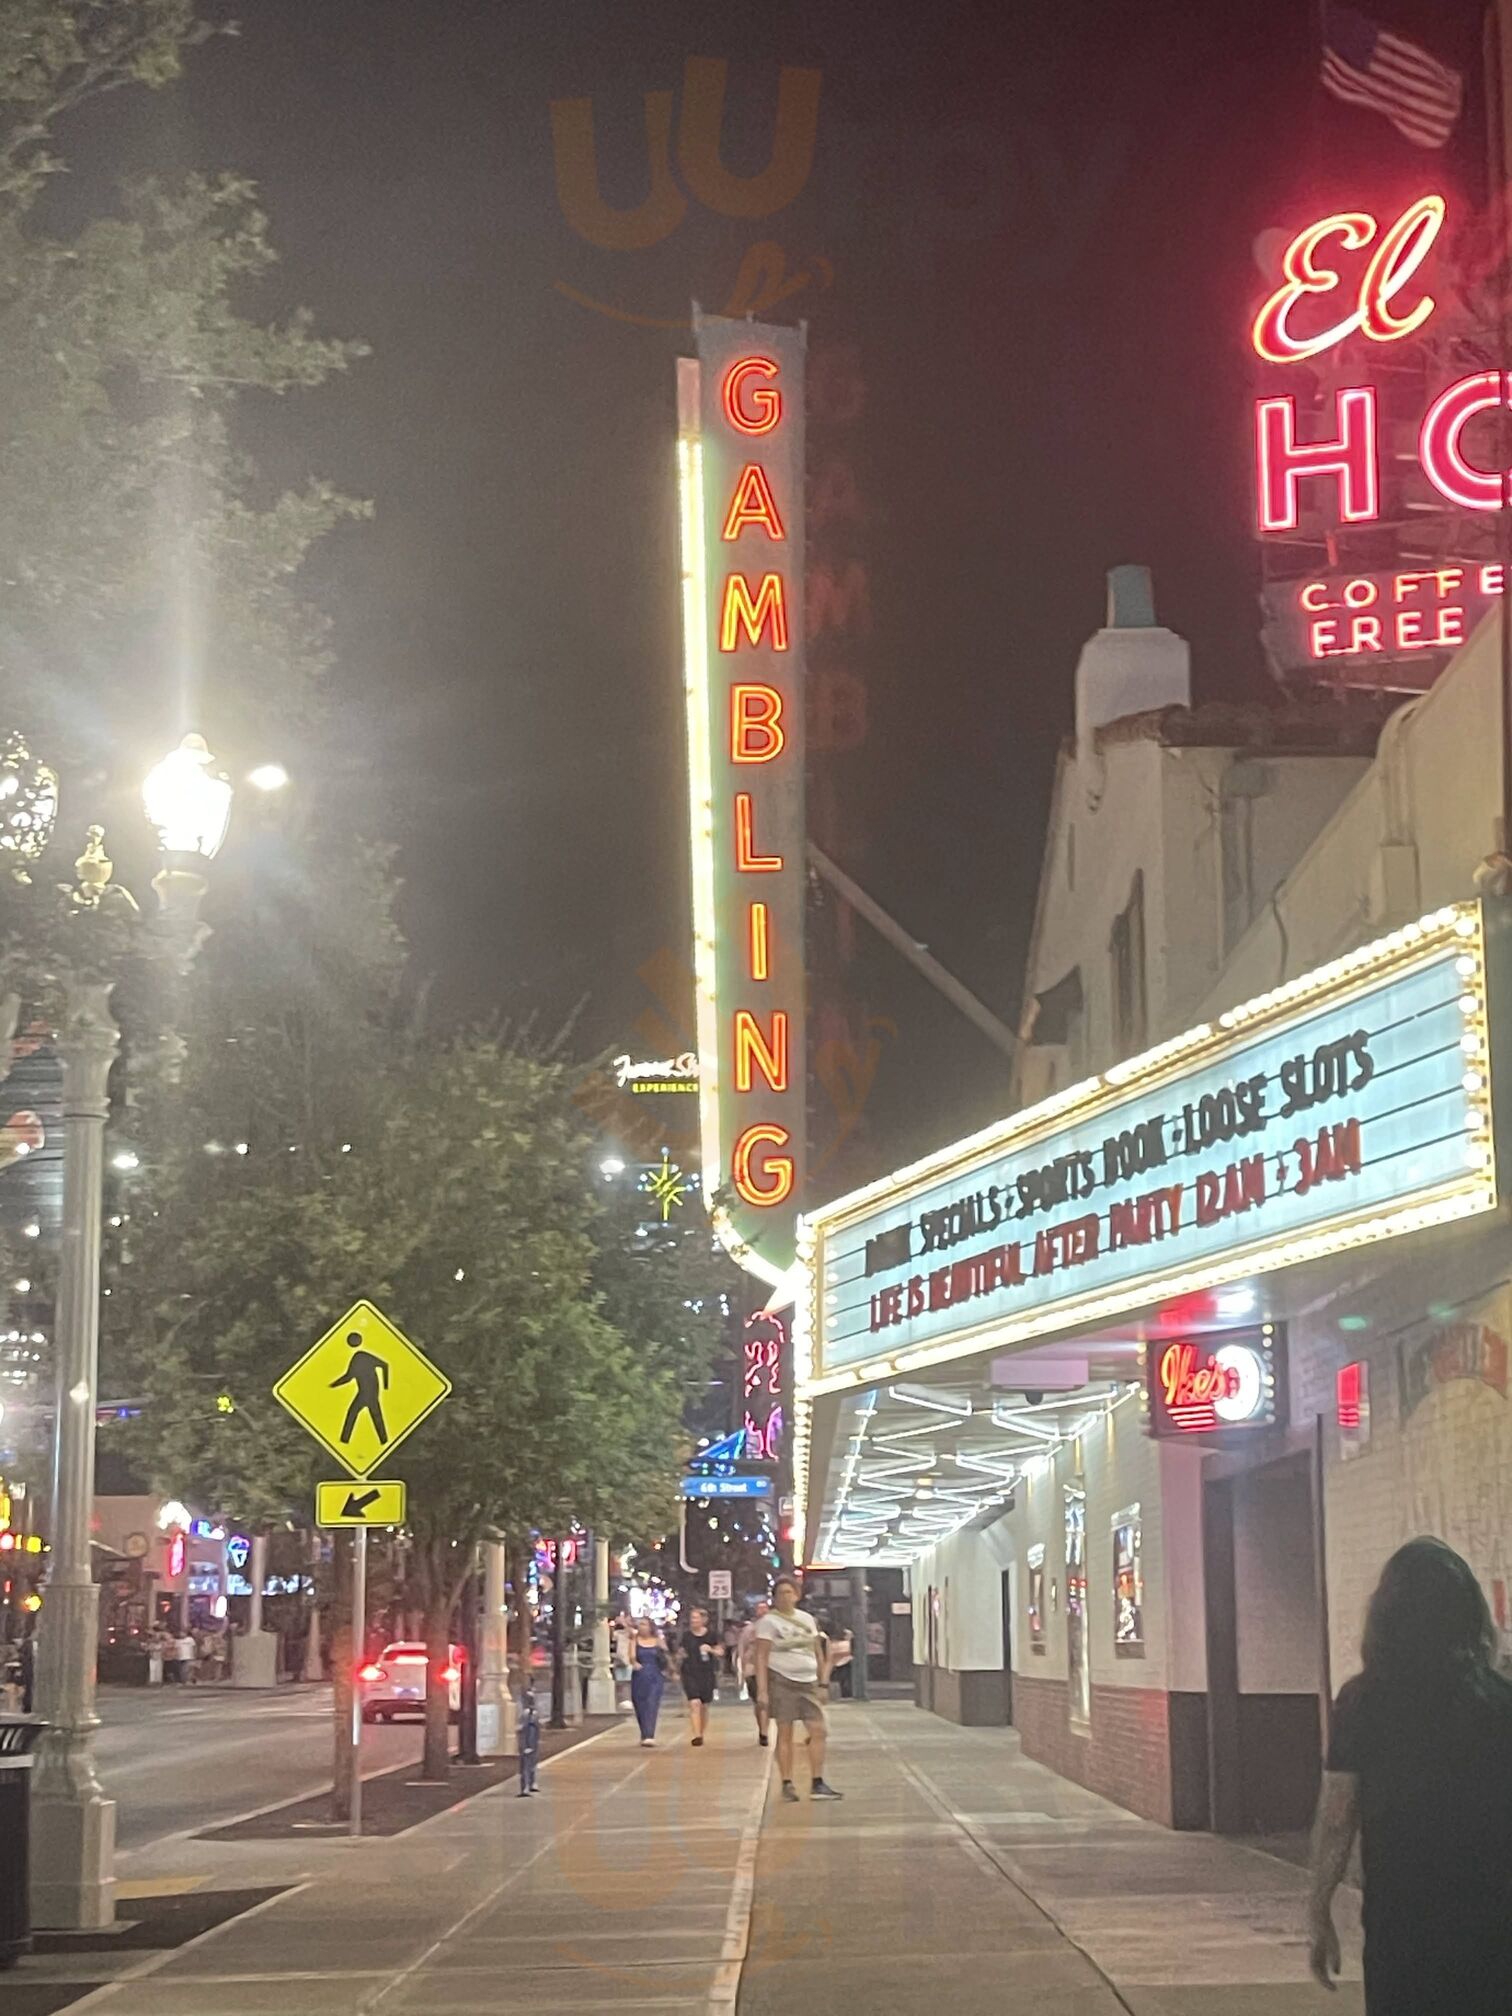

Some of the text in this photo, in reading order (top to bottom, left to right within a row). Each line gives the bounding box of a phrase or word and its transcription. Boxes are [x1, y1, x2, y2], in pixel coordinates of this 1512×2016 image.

[1253, 195, 1445, 363] El
[1300, 564, 1505, 612] COFFE
[1311, 606, 1464, 659] FREE
[719, 356, 794, 1208] GAMBLING
[1016, 1150, 1095, 1219] SPORTS
[1103, 1114, 1167, 1188] BOOK
[1183, 1071, 1267, 1156] LOOSE
[1280, 1029, 1374, 1119] SLOTS
[1033, 1213, 1099, 1277] AFTER
[1110, 1183, 1184, 1252] PARTY
[1161, 1344, 1227, 1406] Ike's
[711, 1585, 729, 1596] 25
